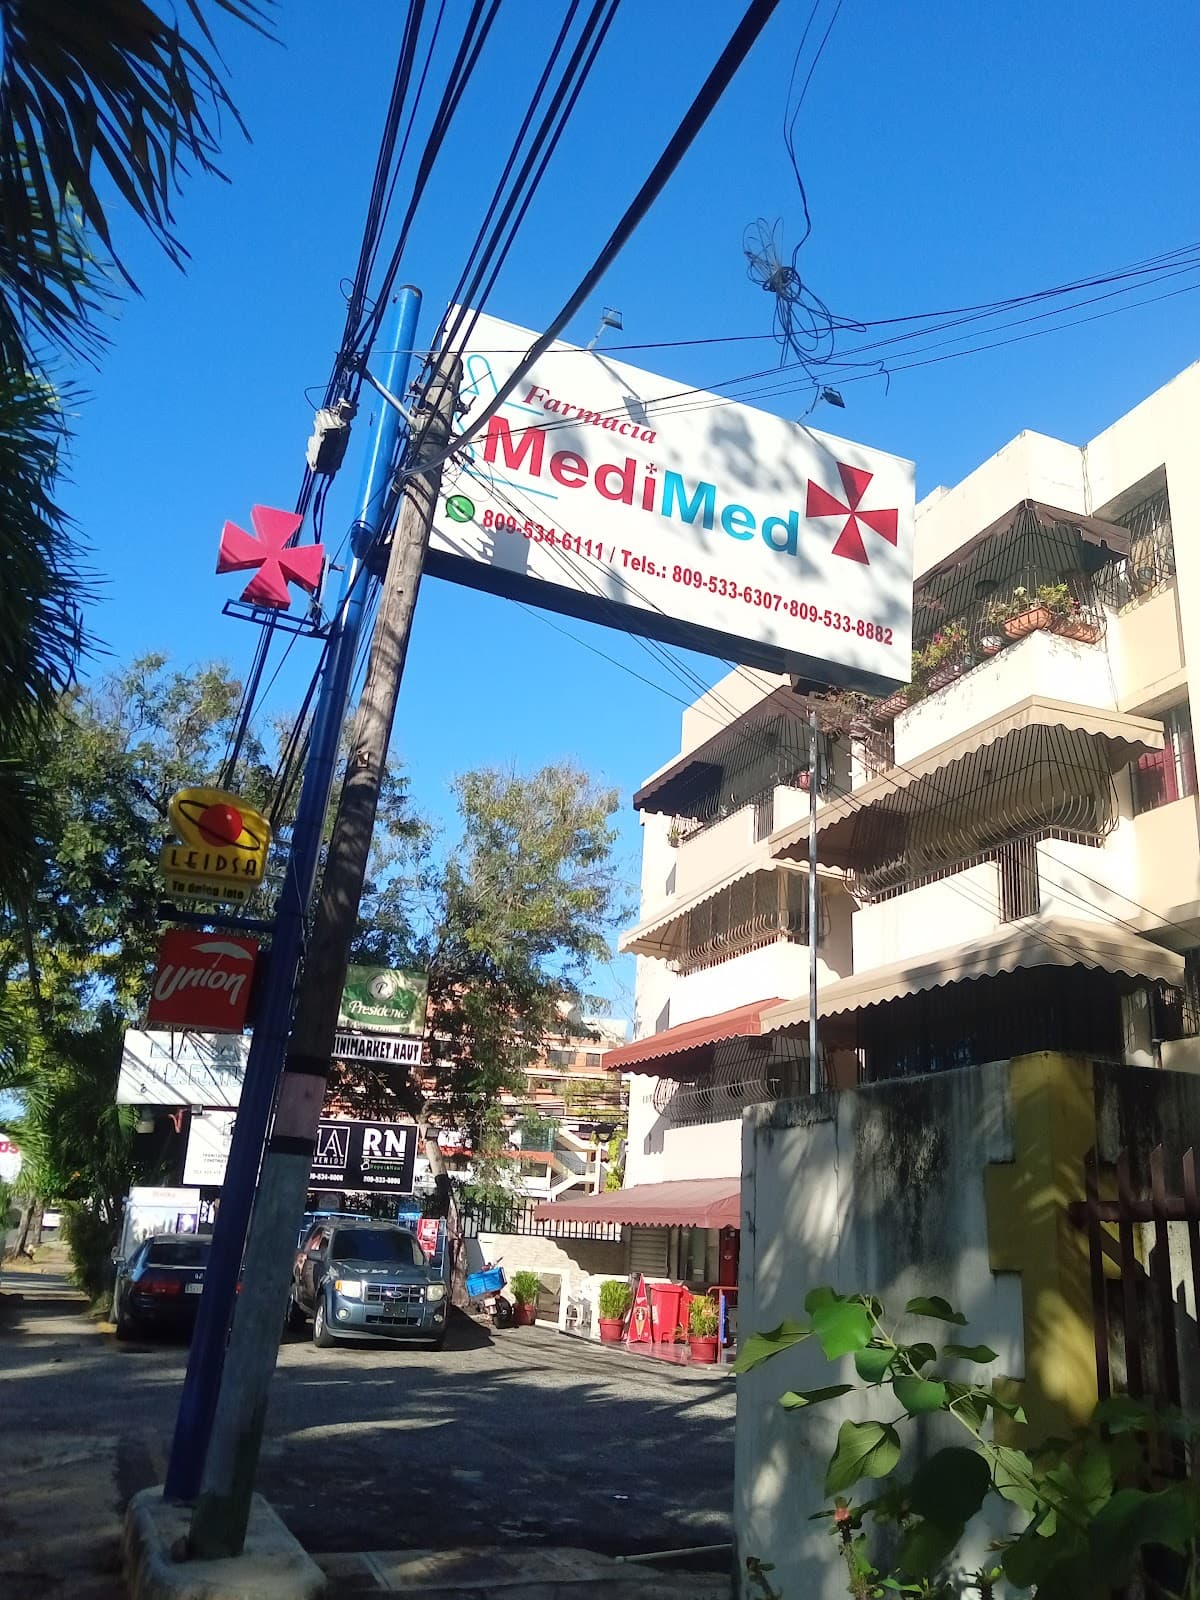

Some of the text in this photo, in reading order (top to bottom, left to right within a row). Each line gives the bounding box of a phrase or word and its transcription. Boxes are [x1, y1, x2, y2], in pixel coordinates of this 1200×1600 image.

[523, 385, 657, 444] Farmacia
[483, 415, 799, 557] MediMed
[483, 509, 603, 560] 809-534-6111
[621, 549, 667, 579] Tels.:
[171, 849, 257, 876] LEIDSA
[348, 1000, 409, 1019] Presidente
[332, 1036, 392, 1059] INIMARKET
[362, 1127, 407, 1157] RN
